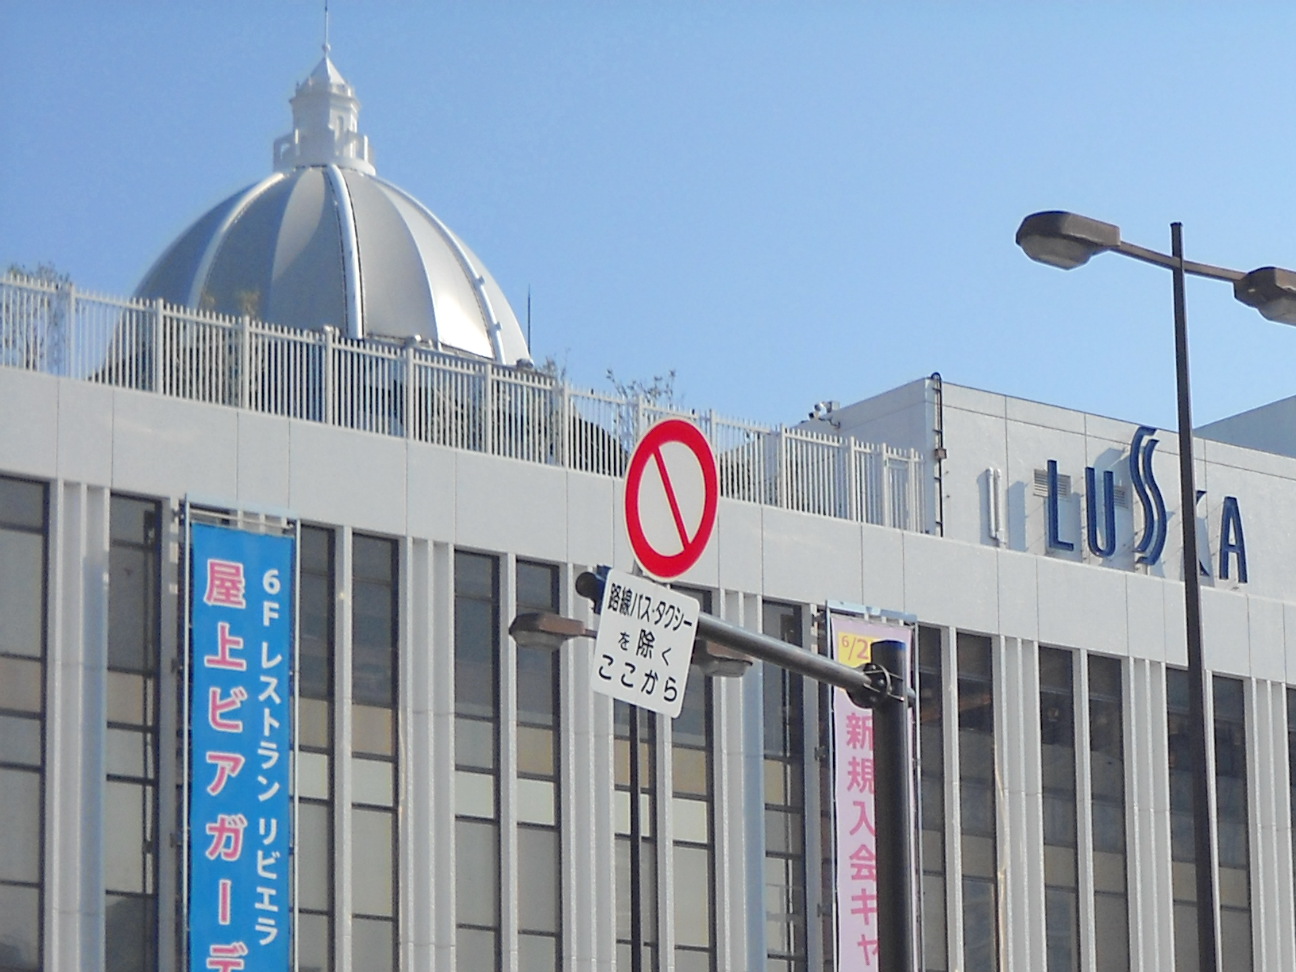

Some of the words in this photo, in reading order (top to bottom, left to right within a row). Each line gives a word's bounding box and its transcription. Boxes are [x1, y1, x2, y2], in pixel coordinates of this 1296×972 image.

[1047, 426, 1248, 583] LUSA
[618, 629, 672, 667] を除く
[598, 654, 678, 703] ここから
